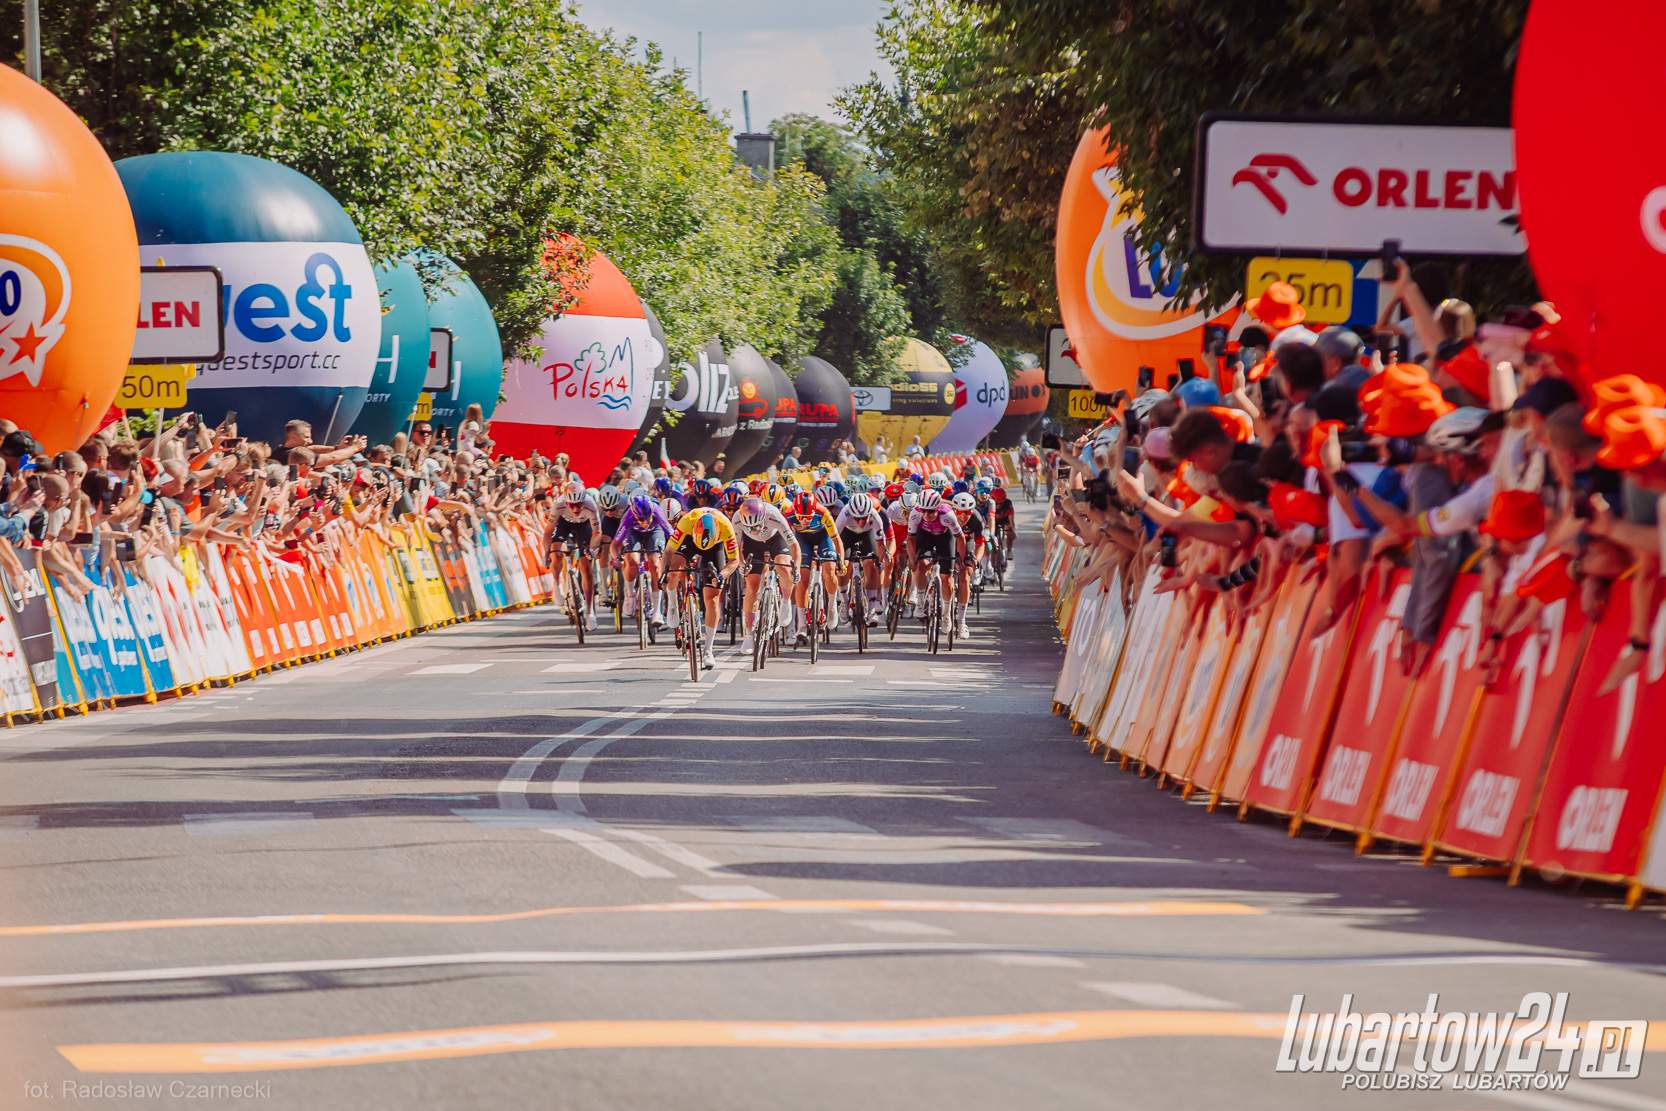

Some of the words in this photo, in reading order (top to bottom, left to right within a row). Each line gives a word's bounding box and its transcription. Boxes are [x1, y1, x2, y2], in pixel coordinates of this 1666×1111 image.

[1333, 167, 1517, 210] ORLEN
[1260, 271, 1342, 308] 5m
[976, 382, 1006, 407] dpd
